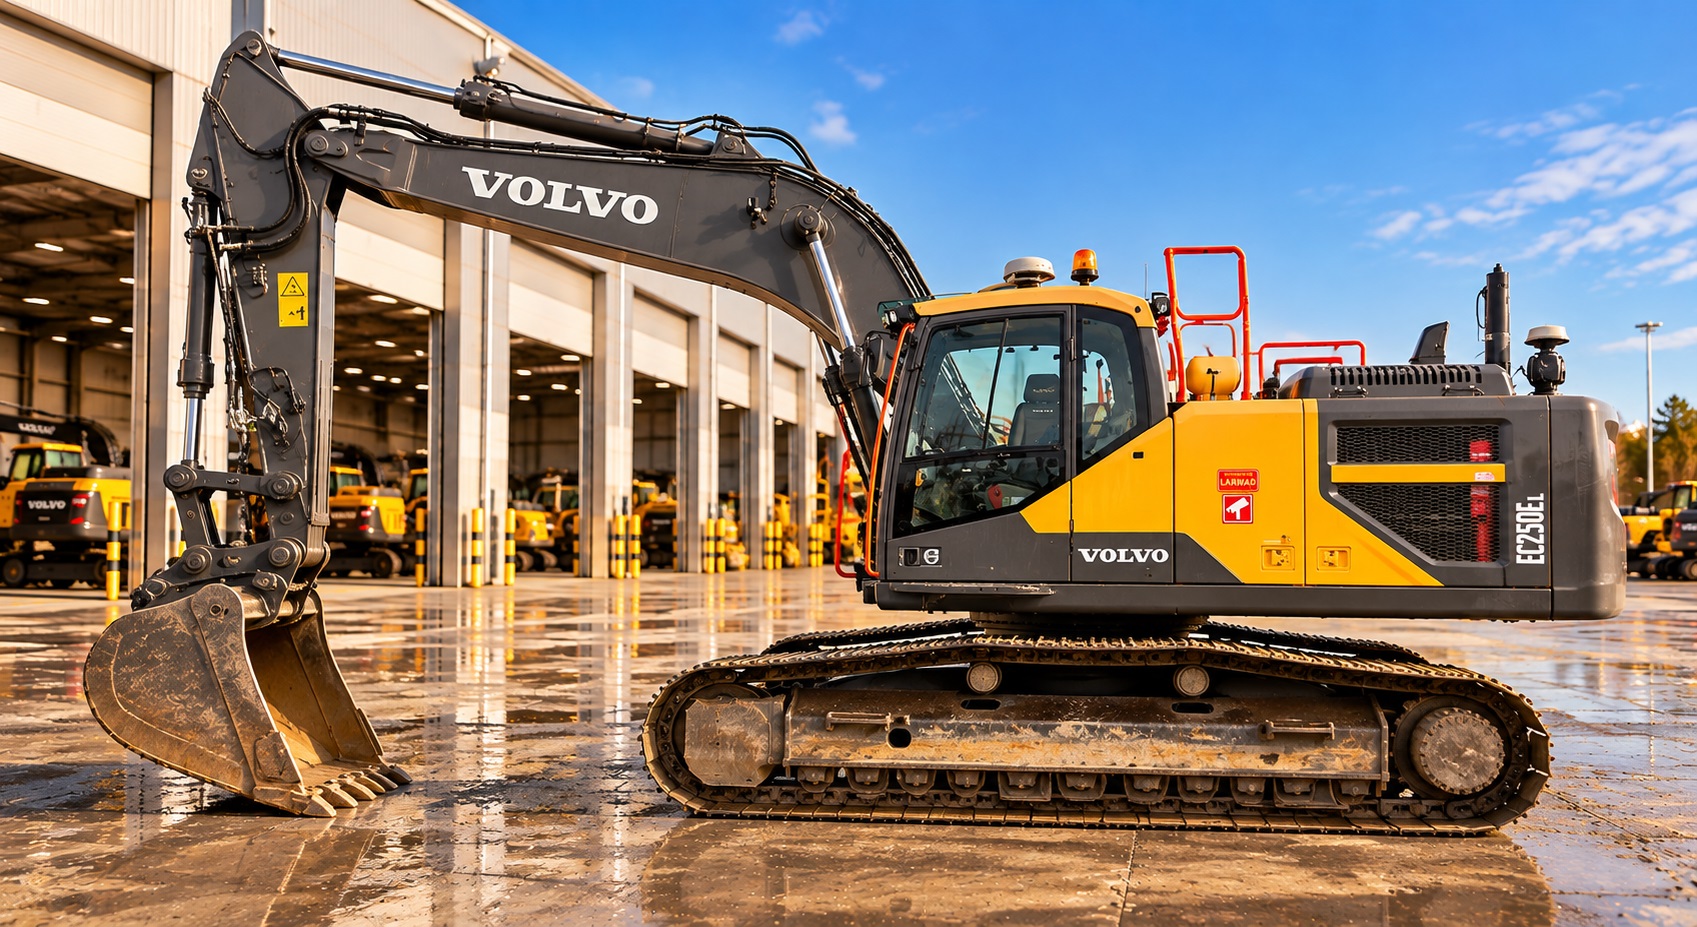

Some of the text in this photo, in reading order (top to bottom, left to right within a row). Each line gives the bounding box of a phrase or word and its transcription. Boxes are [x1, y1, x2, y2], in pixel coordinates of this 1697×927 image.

[461, 166, 659, 225] VOLVO
[28, 500, 66, 510] VOLVO
[1078, 549, 1170, 563] VOLVO
